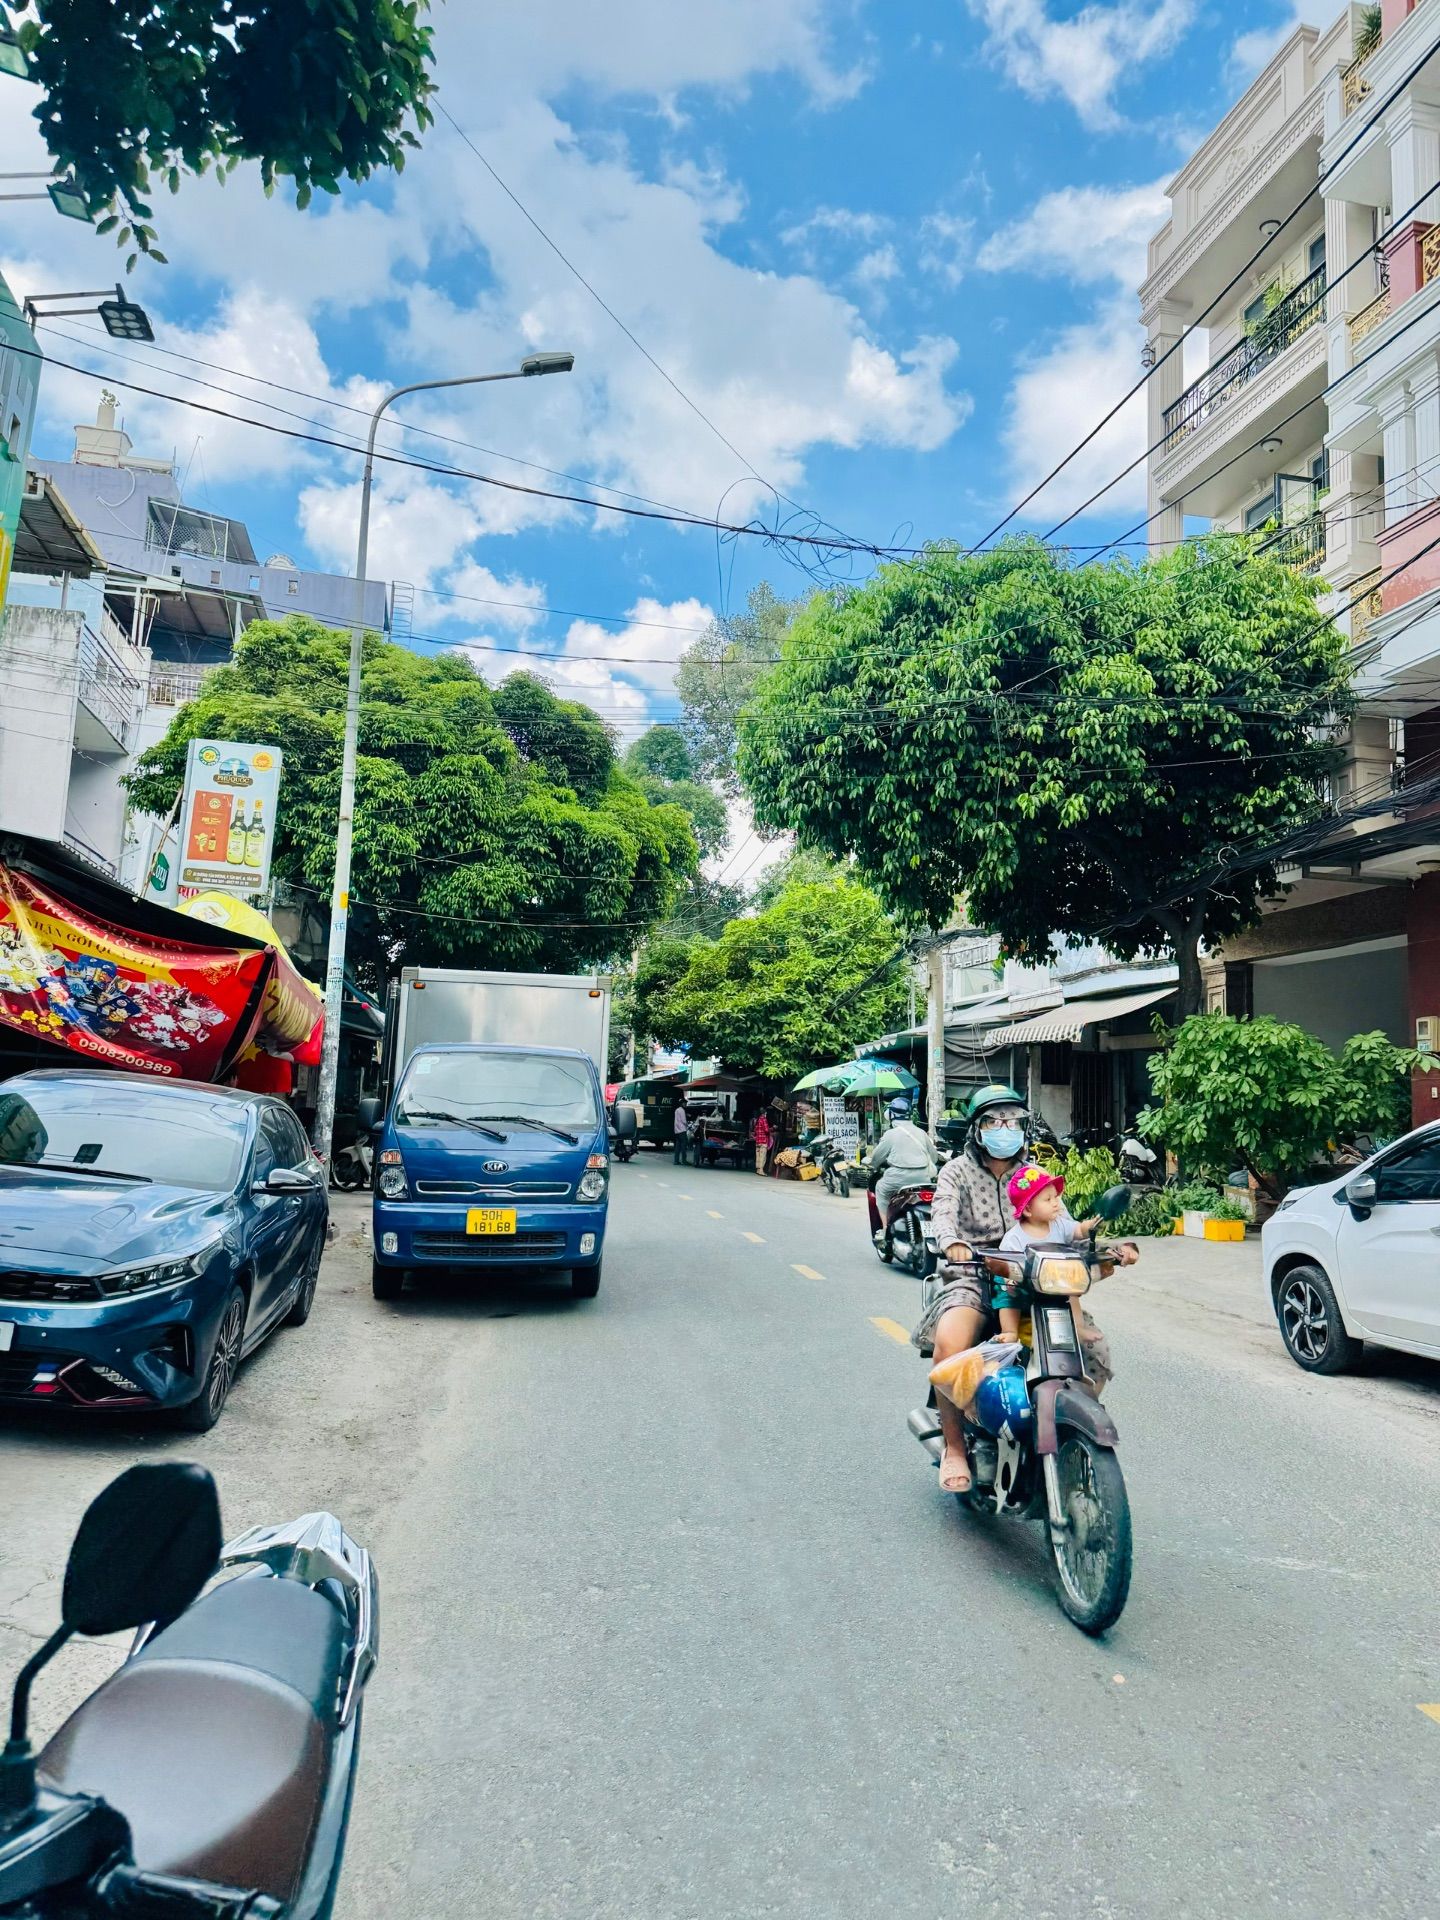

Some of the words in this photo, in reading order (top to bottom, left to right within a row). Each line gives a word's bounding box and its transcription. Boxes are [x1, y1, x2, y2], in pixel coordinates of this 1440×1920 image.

[79, 1037, 172, 1075] 0908200389
[486, 1162, 504, 1171] KIA
[481, 1210, 503, 1221] 50H
[474, 1222, 511, 1232] 181.68
